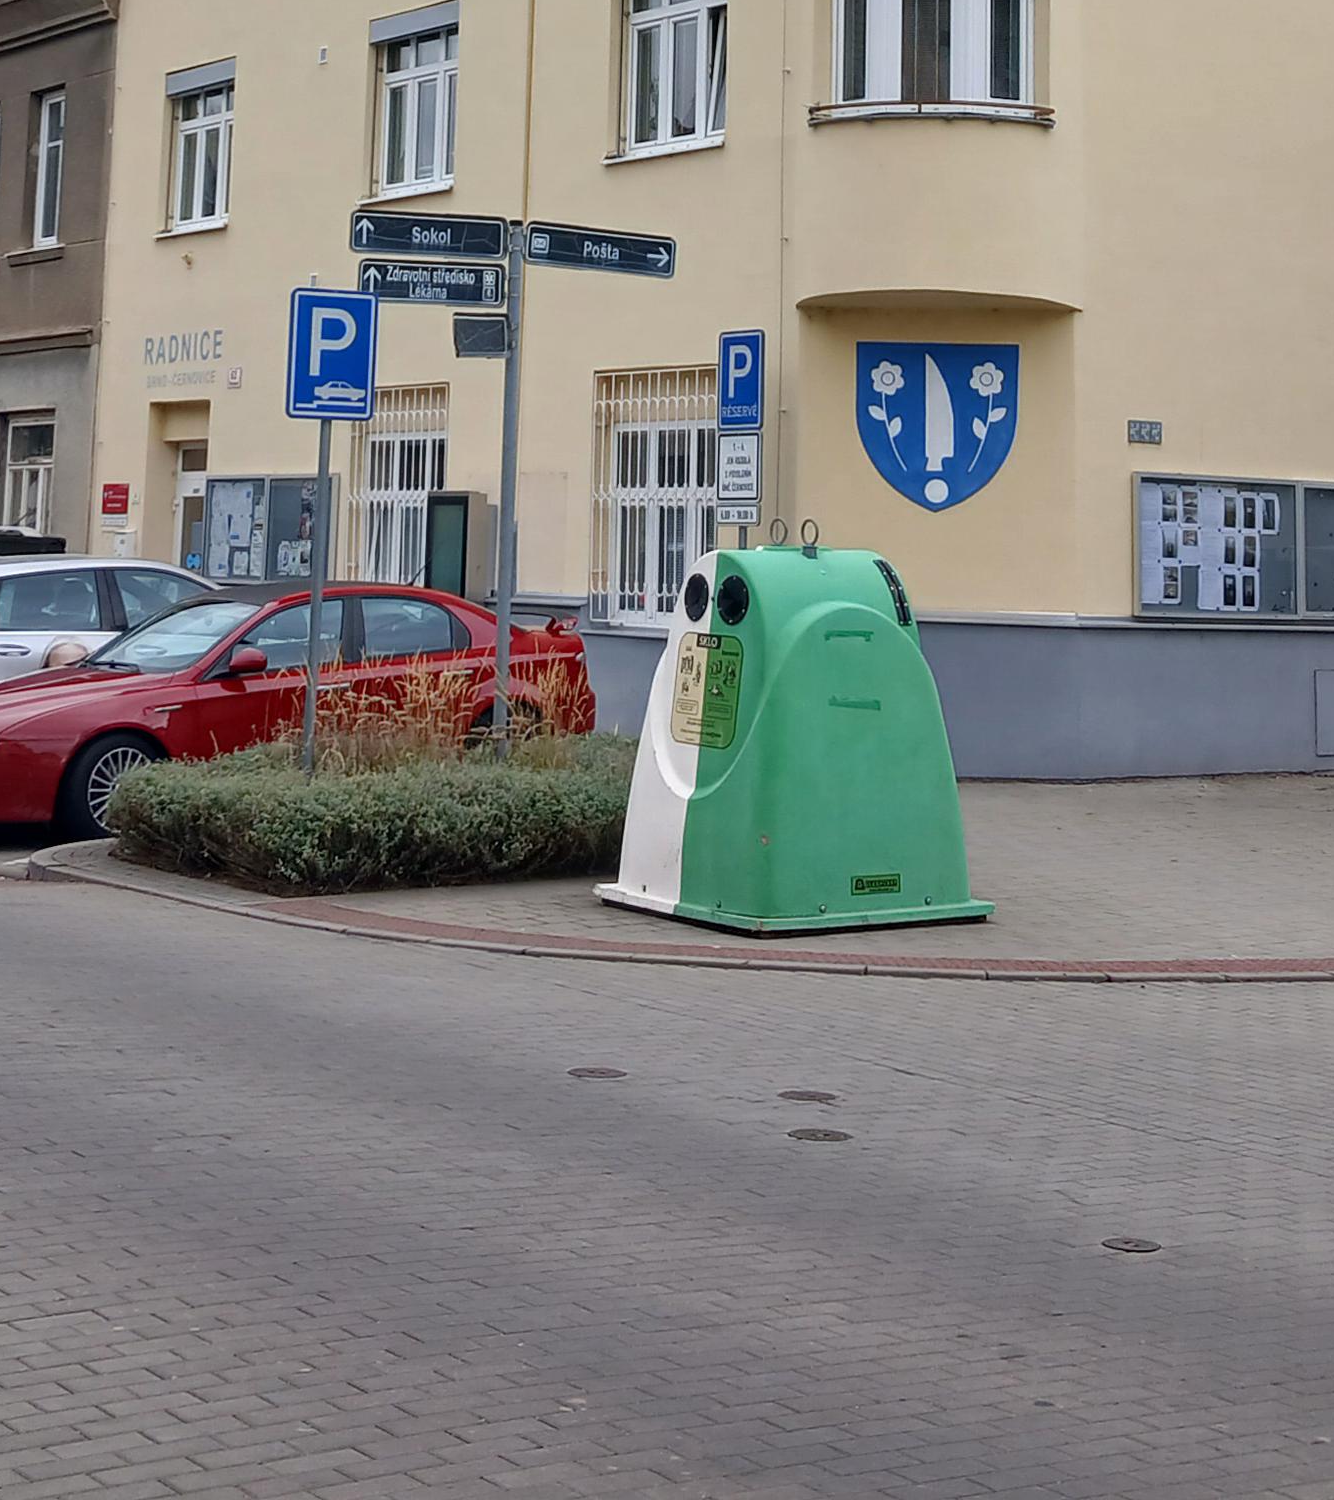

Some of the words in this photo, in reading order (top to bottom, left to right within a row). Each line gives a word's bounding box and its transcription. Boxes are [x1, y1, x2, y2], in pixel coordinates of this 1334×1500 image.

[411, 226, 451, 245] Sokol
[582, 240, 620, 260] Pošta
[386, 265, 431, 283] Zdravotní
[432, 268, 476, 285] středisko
[409, 282, 447, 300] Lékárna
[144, 329, 223, 365] RADNICE
[309, 307, 357, 376] P
[728, 344, 753, 399] P
